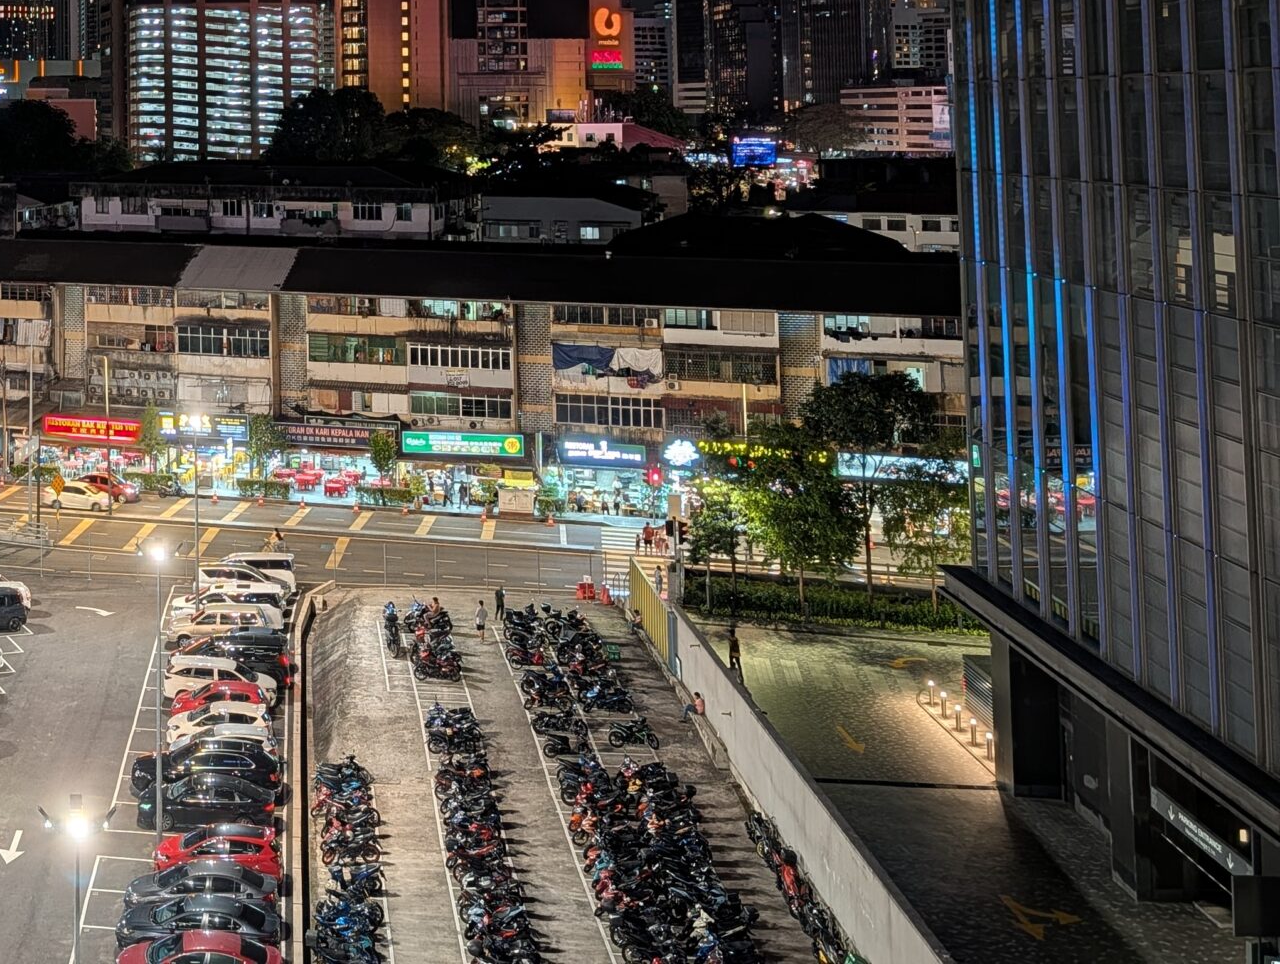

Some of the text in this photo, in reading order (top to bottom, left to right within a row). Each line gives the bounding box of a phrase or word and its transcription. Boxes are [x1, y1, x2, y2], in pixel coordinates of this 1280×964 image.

[315, 427, 330, 436] KARI
[331, 428, 354, 438] KEPALA
[355, 430, 369, 438] IKAN
[1179, 812, 1197, 833] PARKING
